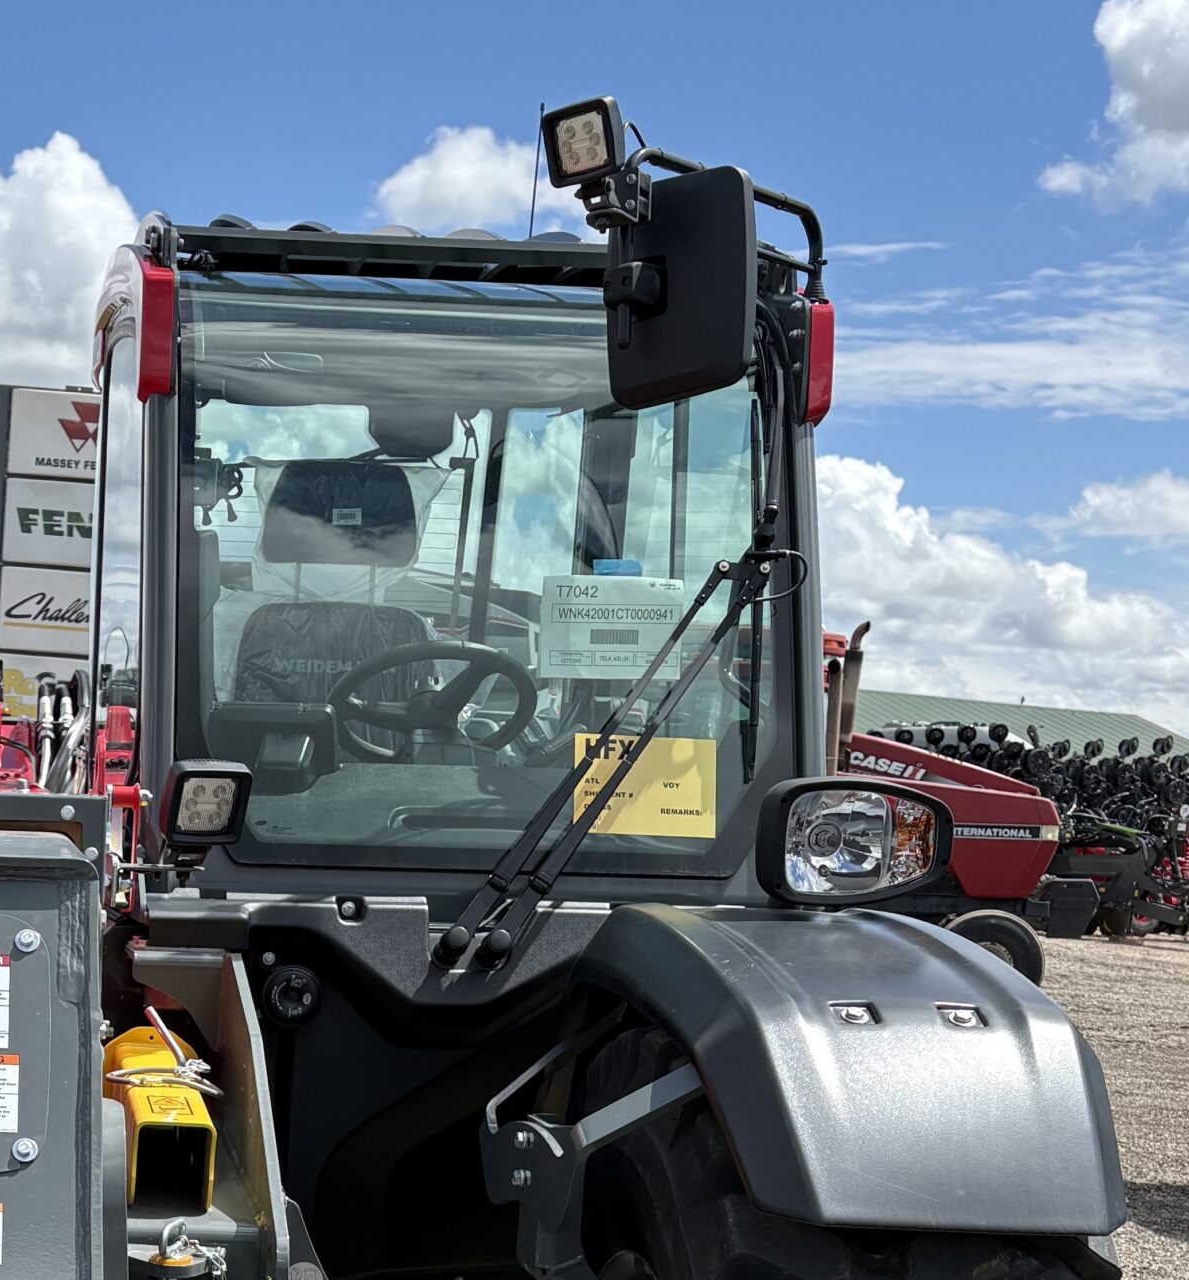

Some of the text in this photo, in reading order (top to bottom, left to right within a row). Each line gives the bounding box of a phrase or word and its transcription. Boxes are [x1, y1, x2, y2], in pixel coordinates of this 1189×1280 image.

[35, 457, 80, 470] MASSEY
[556, 585, 598, 598] T7042
[558, 607, 674, 621] WNK42001CT0000941
[273, 659, 396, 675] WEIDEM
[584, 777, 600, 785] ATL
[584, 790, 626, 798] SHINT
[660, 808, 703, 816] REMARKS:
